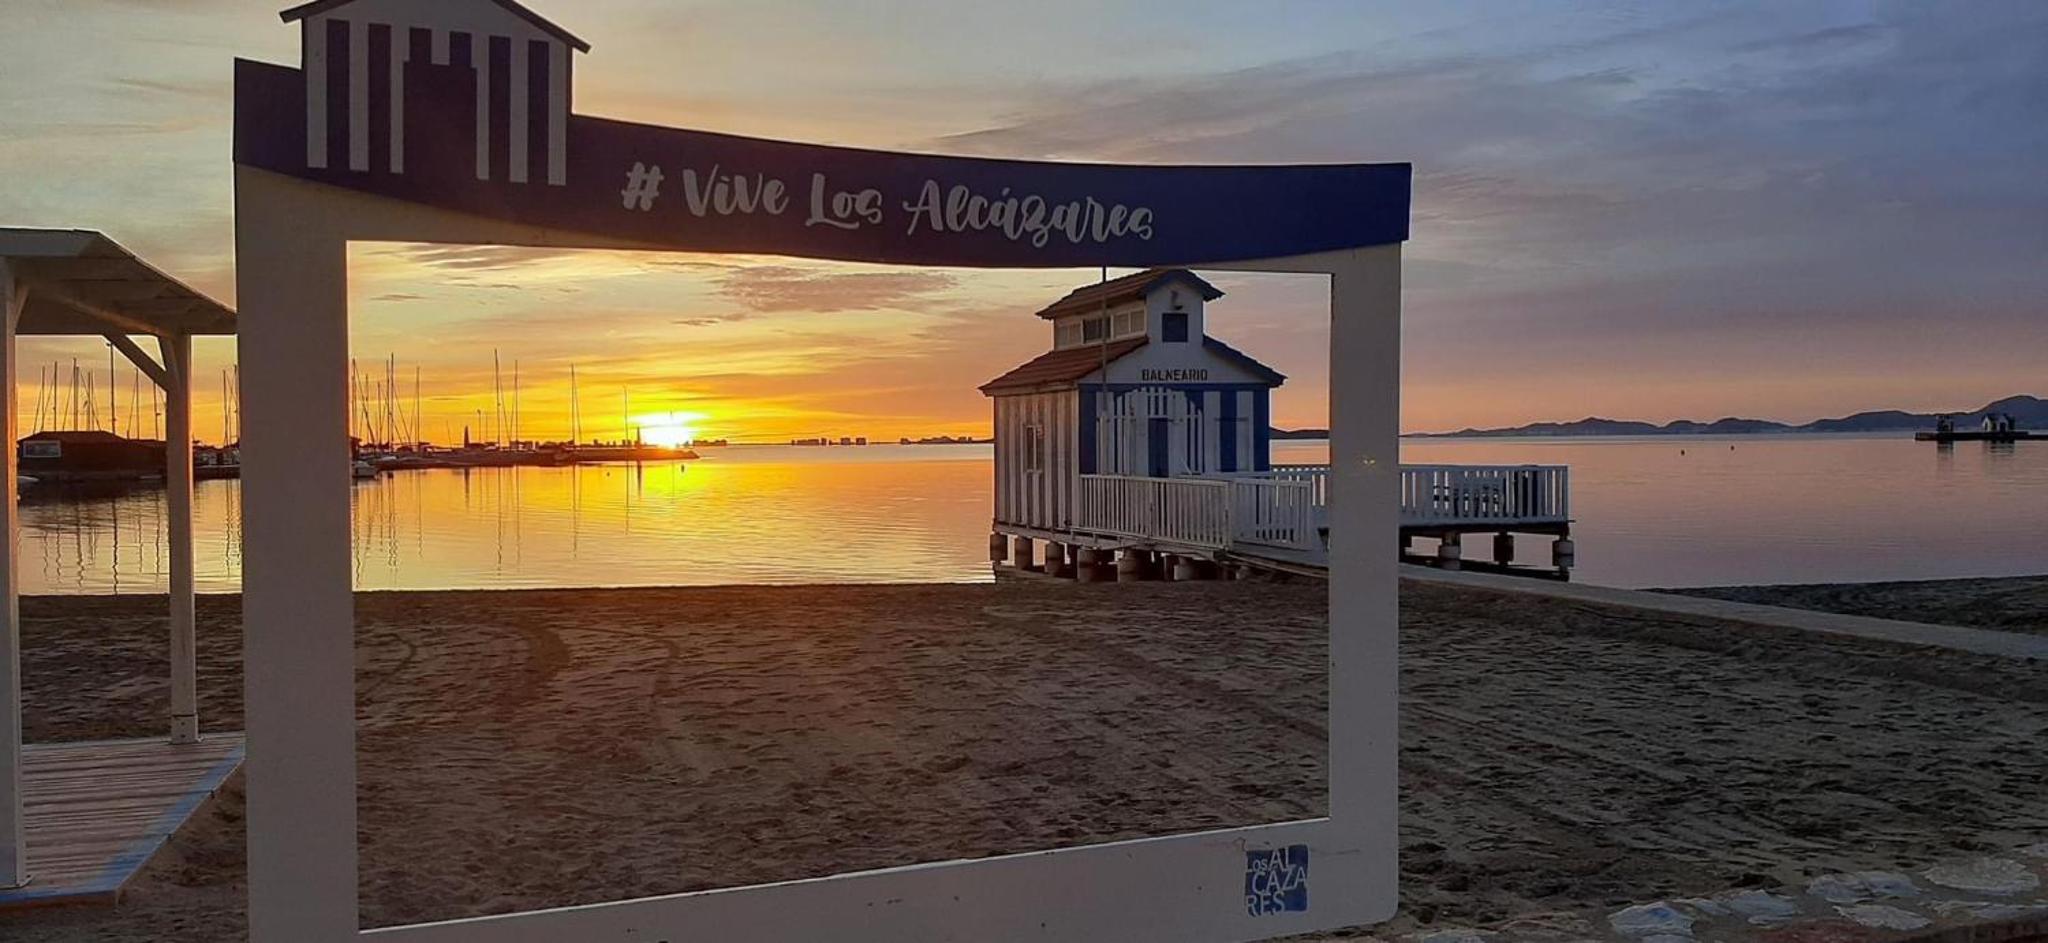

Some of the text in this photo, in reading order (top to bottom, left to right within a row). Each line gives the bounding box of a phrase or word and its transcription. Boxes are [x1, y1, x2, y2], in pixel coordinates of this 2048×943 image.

[683, 164, 790, 217] Vive
[805, 173, 882, 229] Los
[902, 179, 1153, 248] Alcázares
[1141, 368, 1208, 381] BALNEARIO
[1246, 889, 1286, 917] RES
